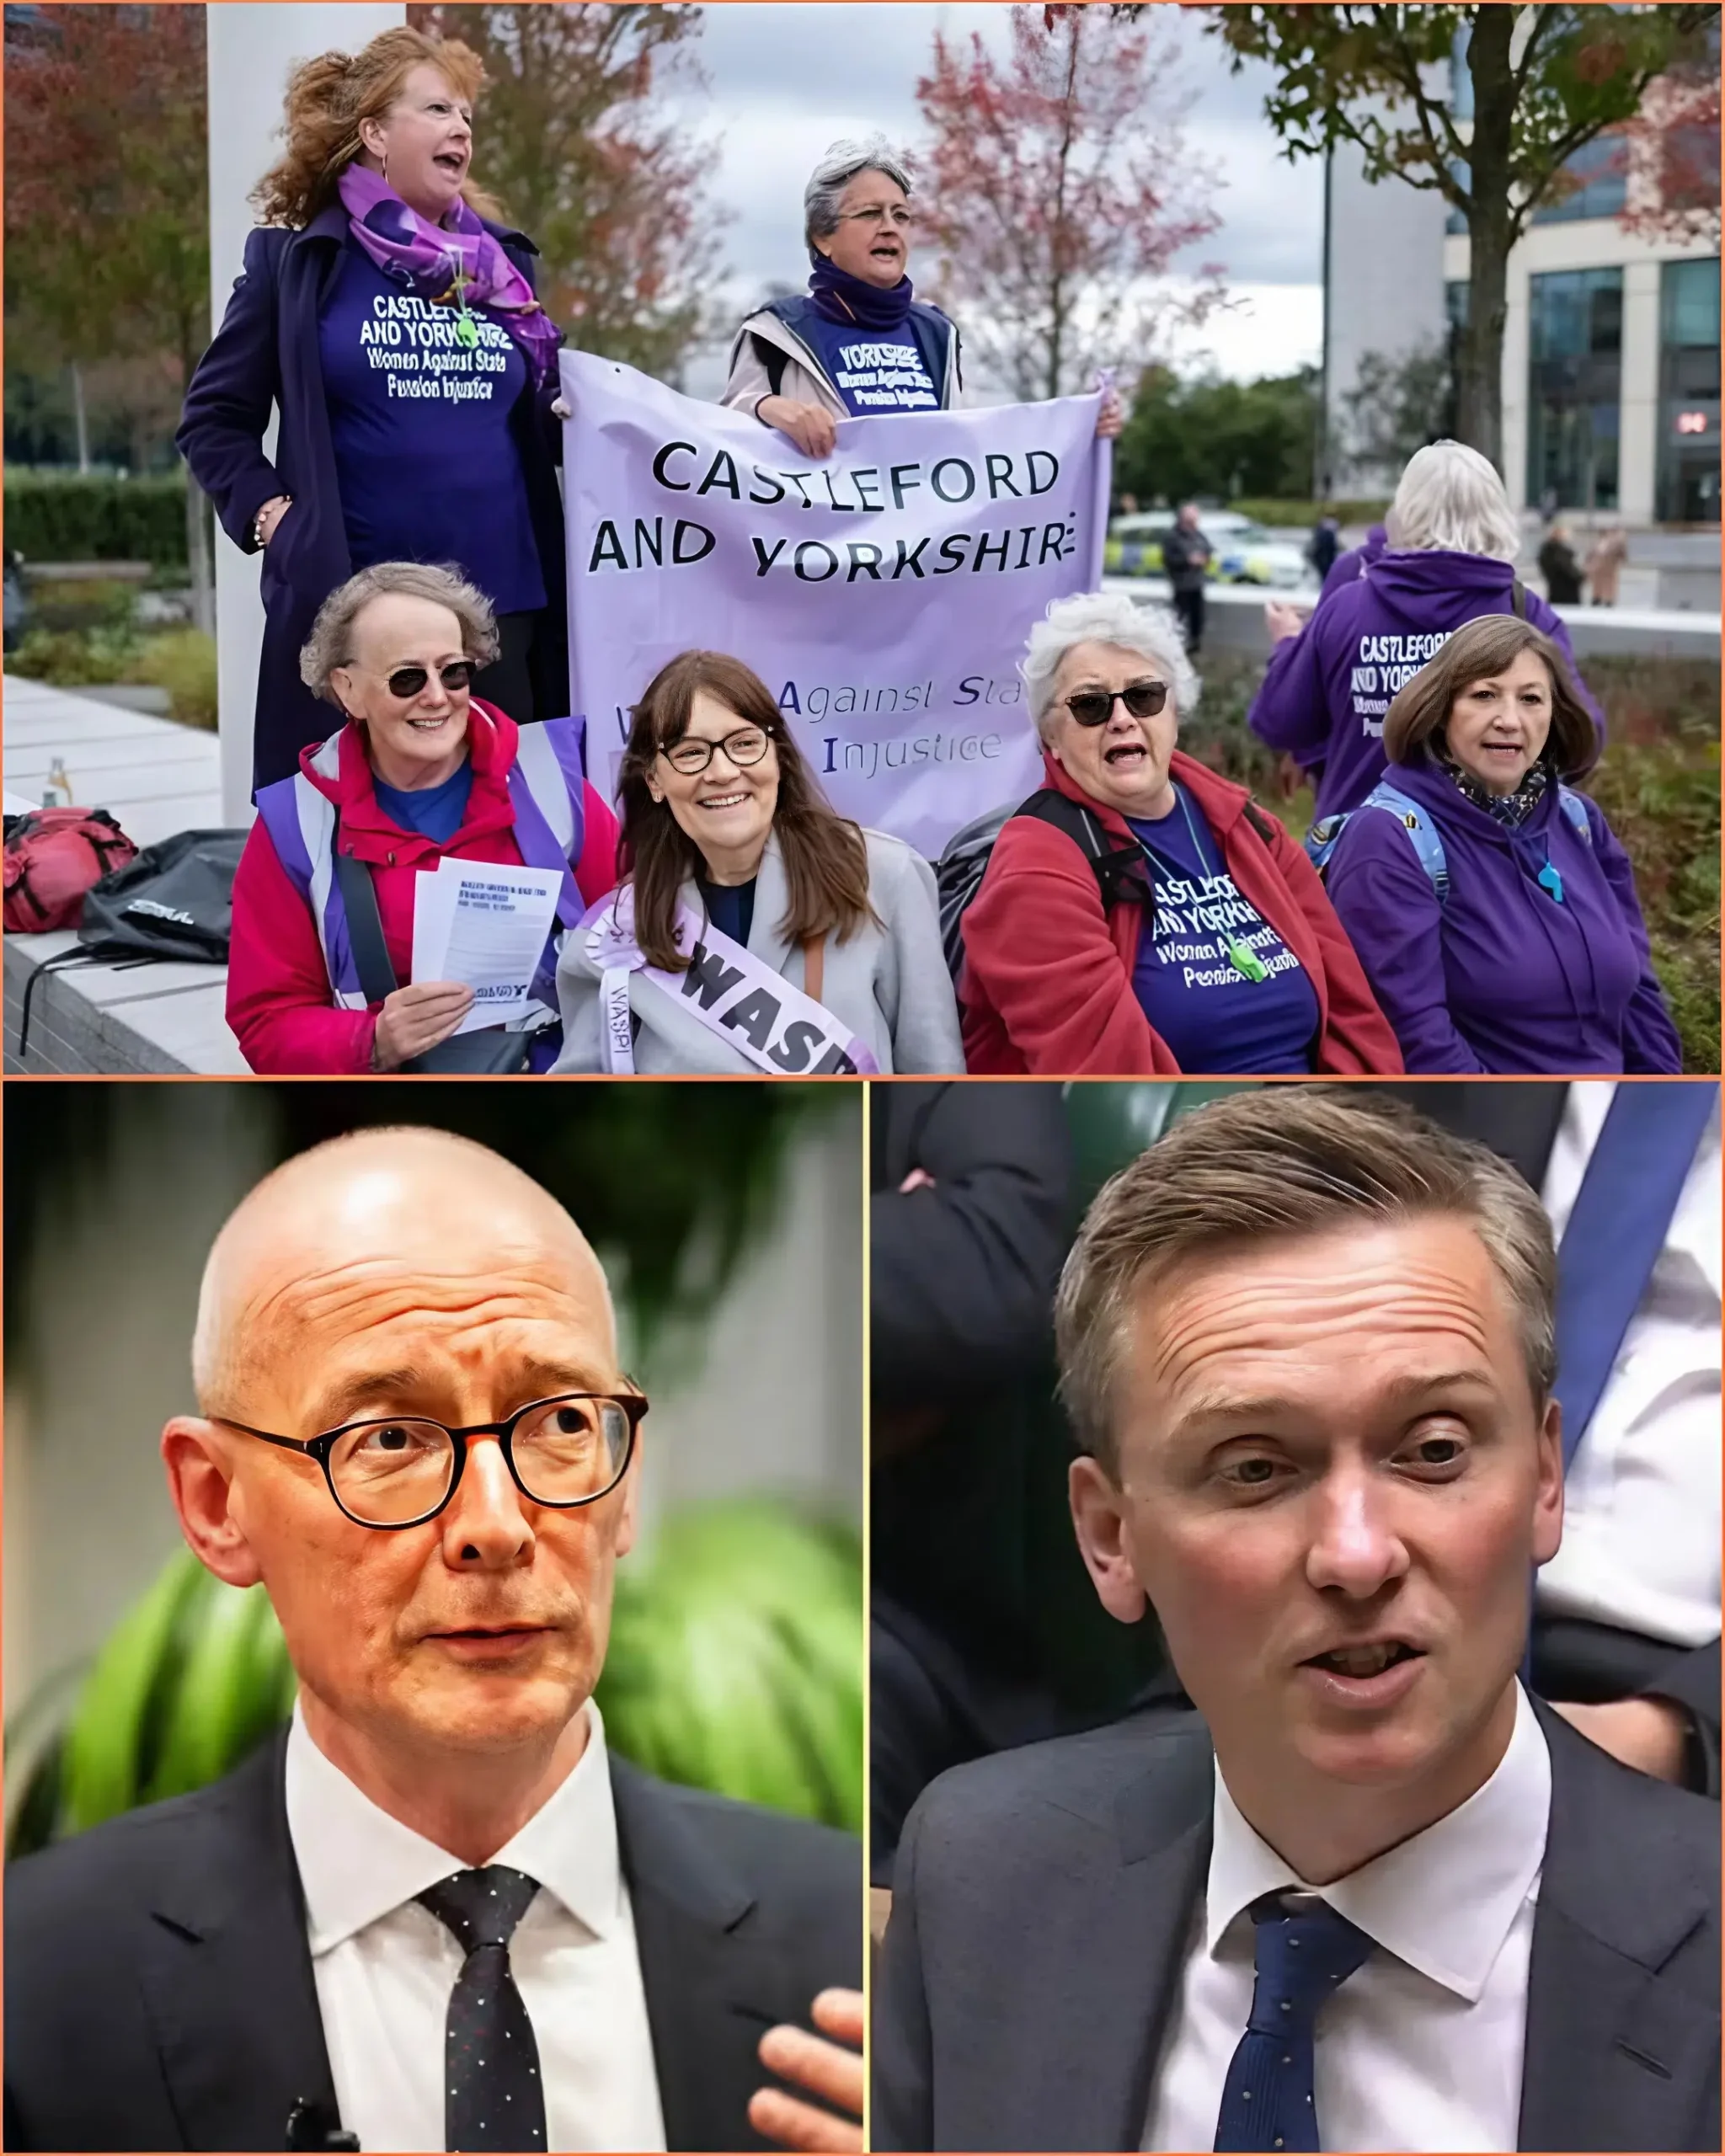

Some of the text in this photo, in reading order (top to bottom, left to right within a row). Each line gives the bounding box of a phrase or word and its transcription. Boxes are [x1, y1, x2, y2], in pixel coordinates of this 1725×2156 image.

[360, 321, 401, 346] AND
[653, 441, 1059, 512] CASTLEFORD
[589, 516, 716, 572] AND
[1360, 632, 1453, 663] CASTLEFOR
[778, 676, 1021, 723] Against Sta
[1351, 666, 1377, 693] AND
[822, 732, 1001, 779] Injustice
